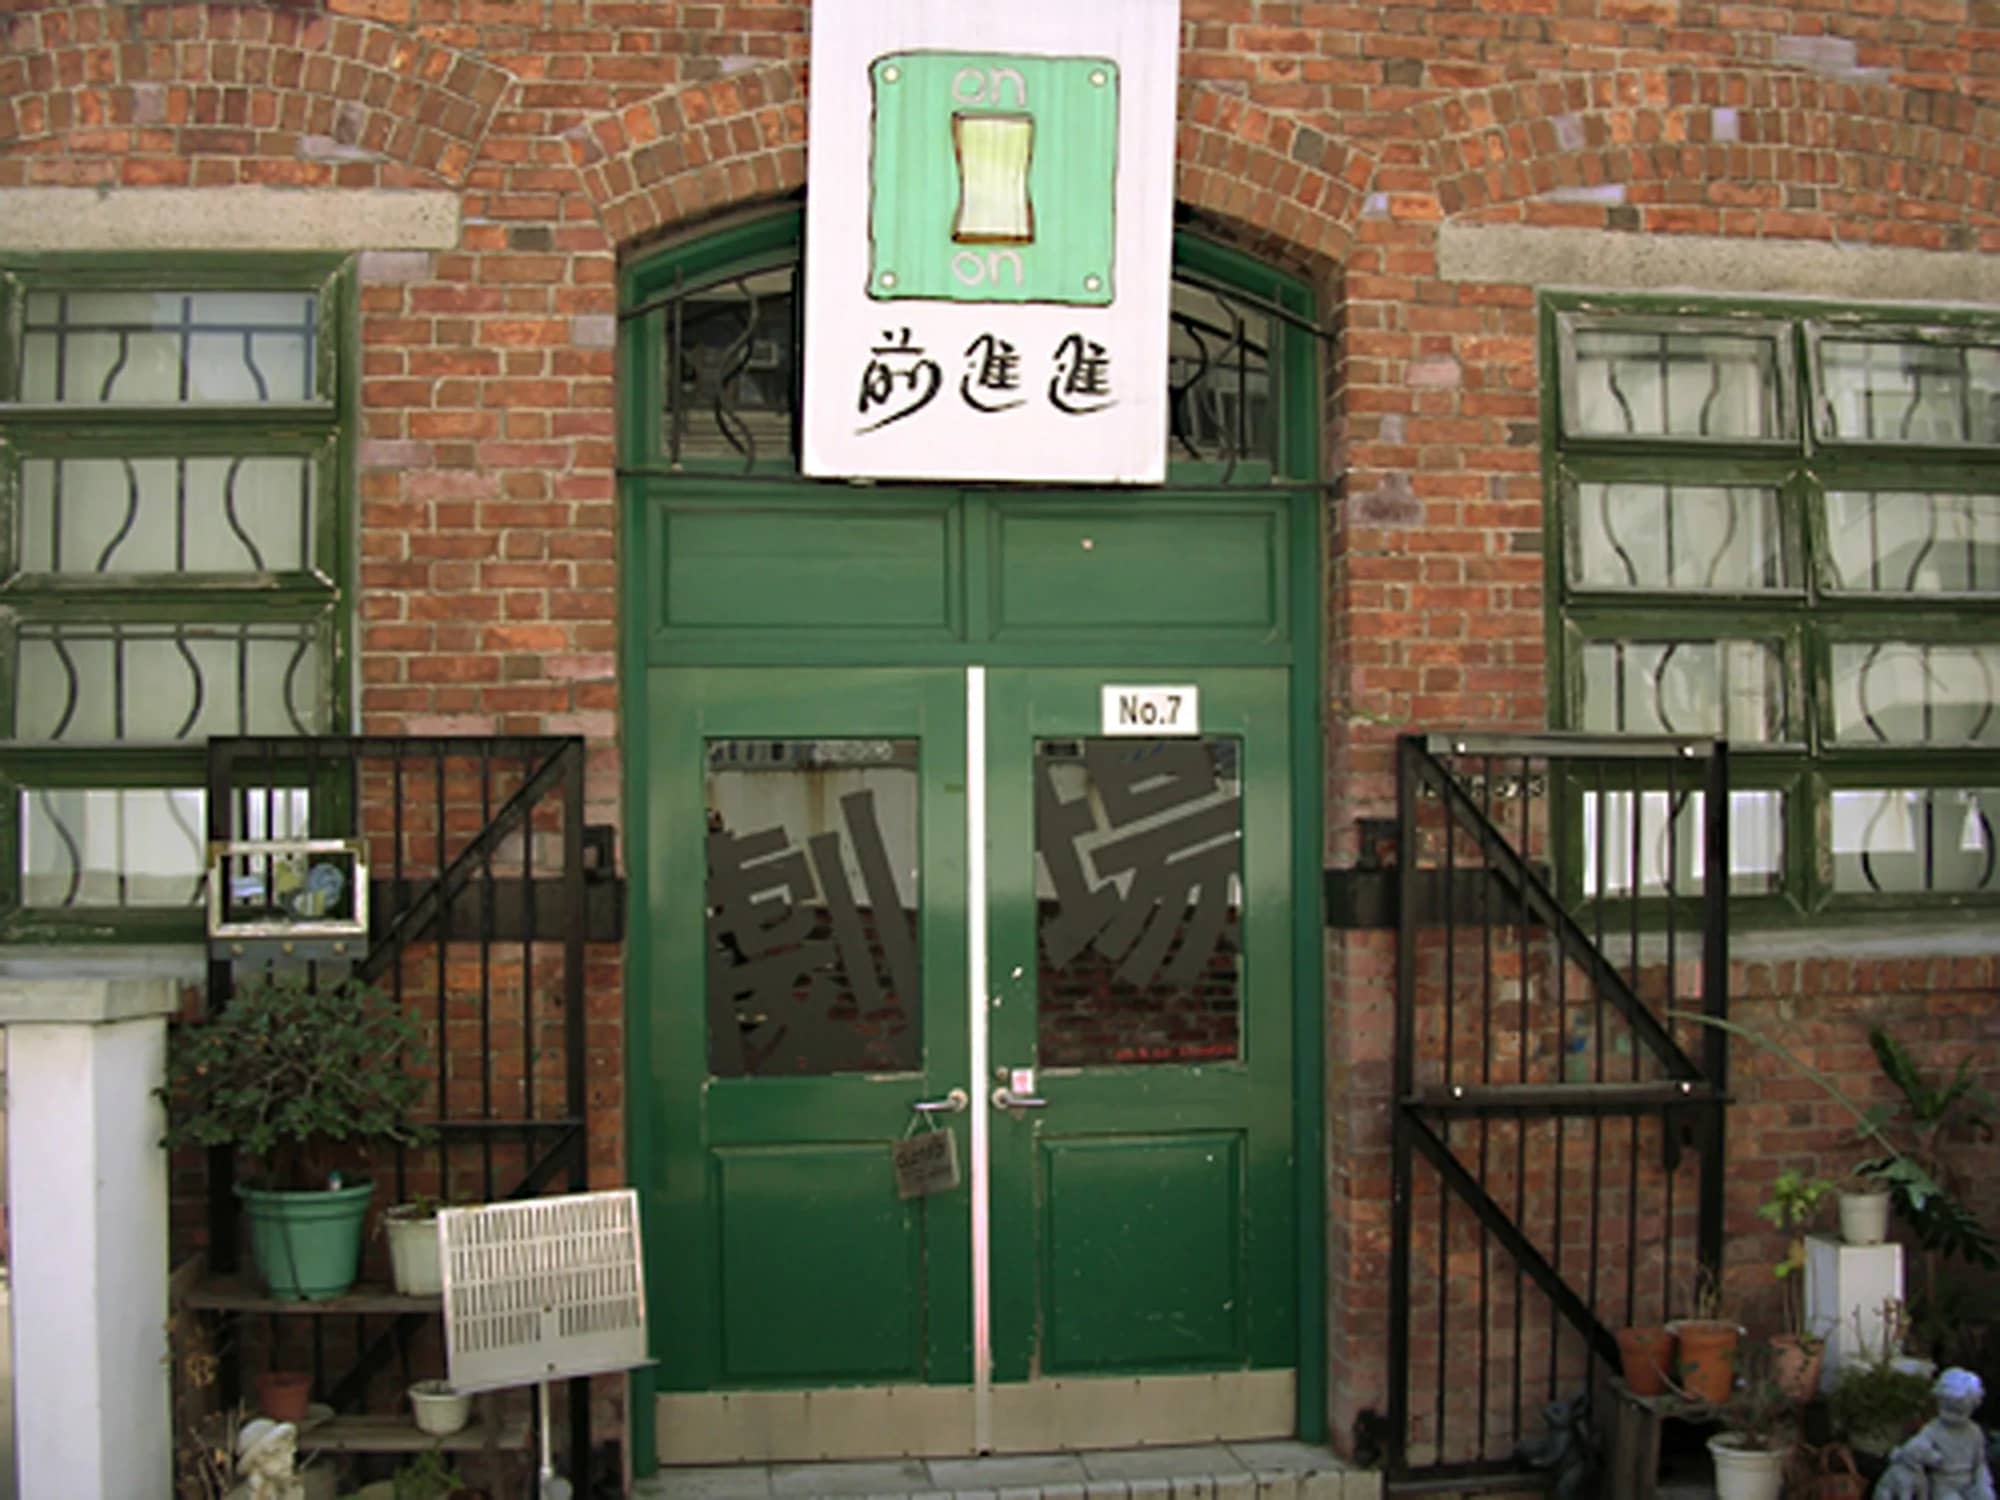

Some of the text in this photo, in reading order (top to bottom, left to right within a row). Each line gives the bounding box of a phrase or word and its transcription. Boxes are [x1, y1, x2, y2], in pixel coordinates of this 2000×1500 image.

[951, 67, 1027, 106] on
[951, 249, 1024, 288] on
[854, 326, 1120, 436] 前進進
[1119, 694, 1182, 724] No.7
